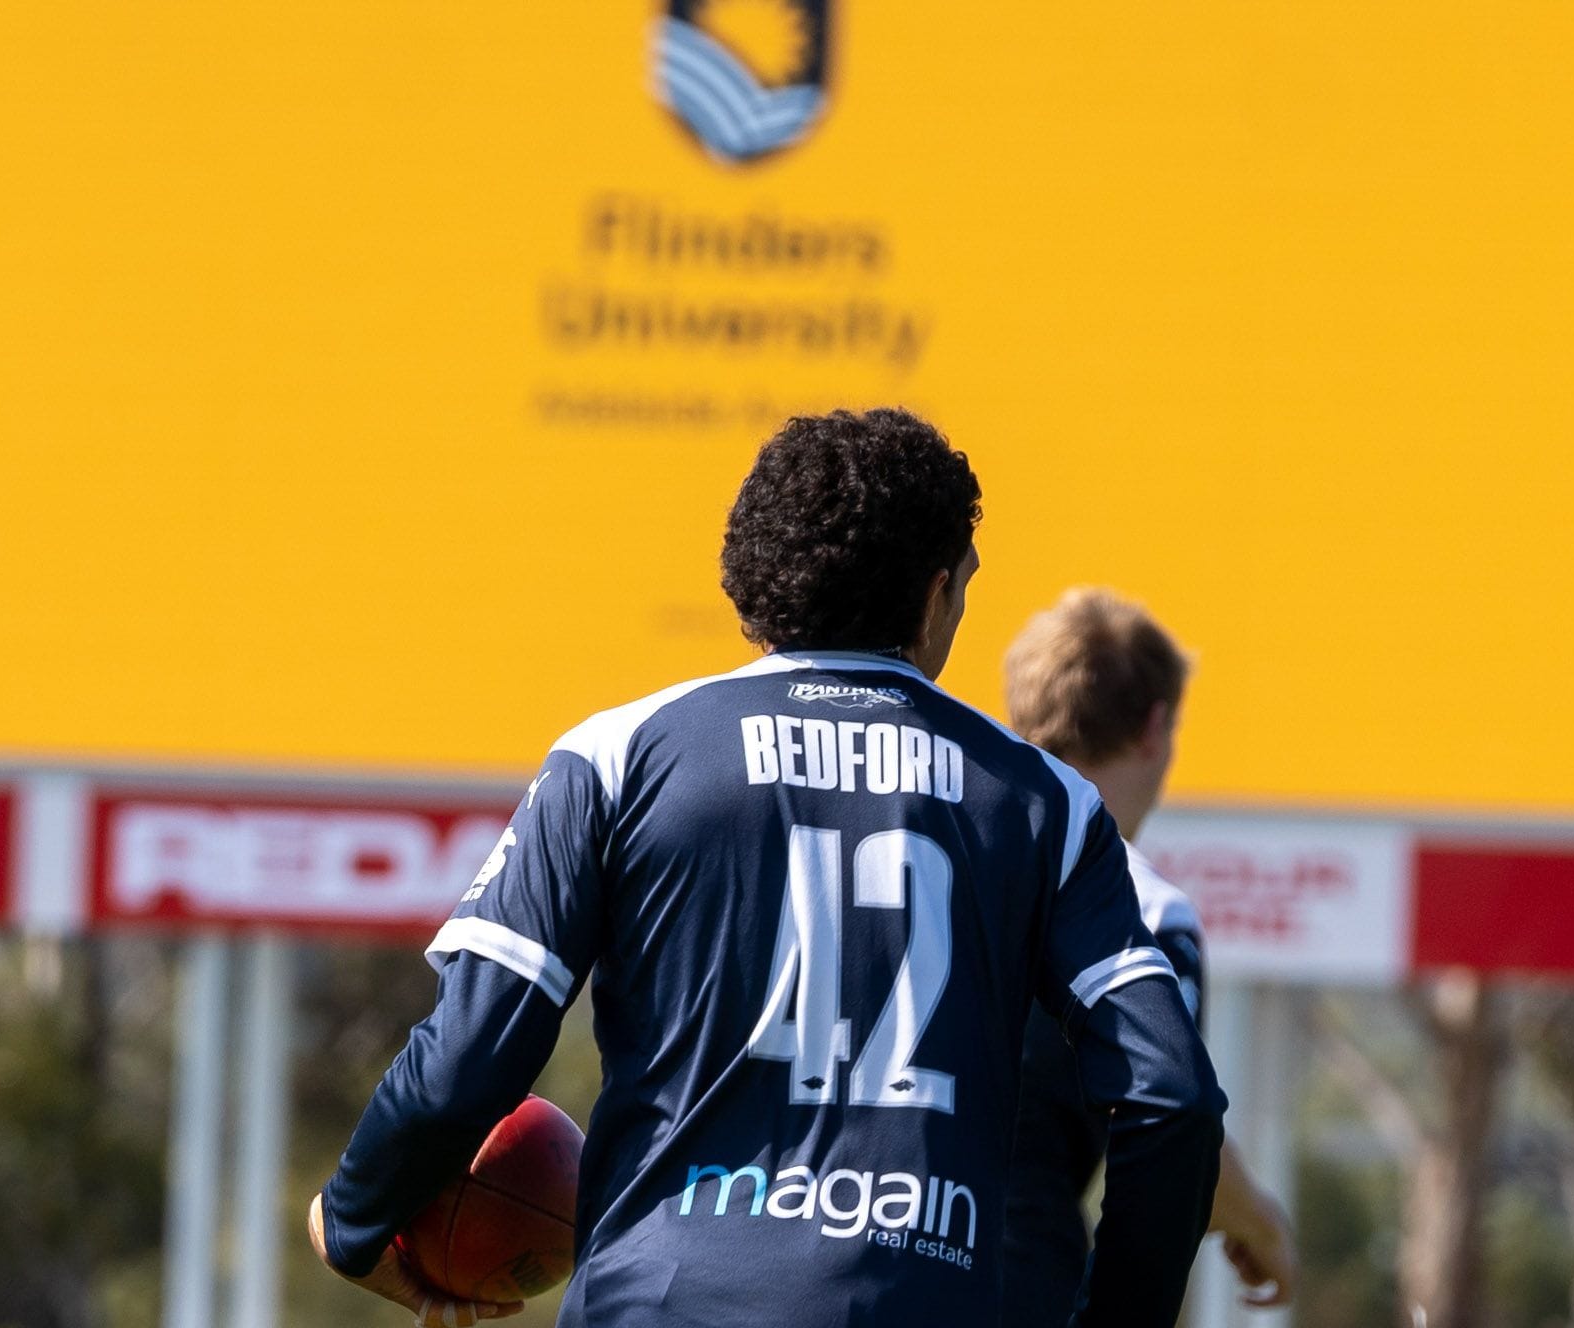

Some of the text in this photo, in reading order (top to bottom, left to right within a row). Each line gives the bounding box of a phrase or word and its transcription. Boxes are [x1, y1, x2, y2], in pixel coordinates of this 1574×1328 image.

[741, 714, 964, 804] BEDFORD
[747, 824, 955, 1114] 42
[679, 1164, 976, 1249] magain
[867, 1228, 973, 1270] real estate
